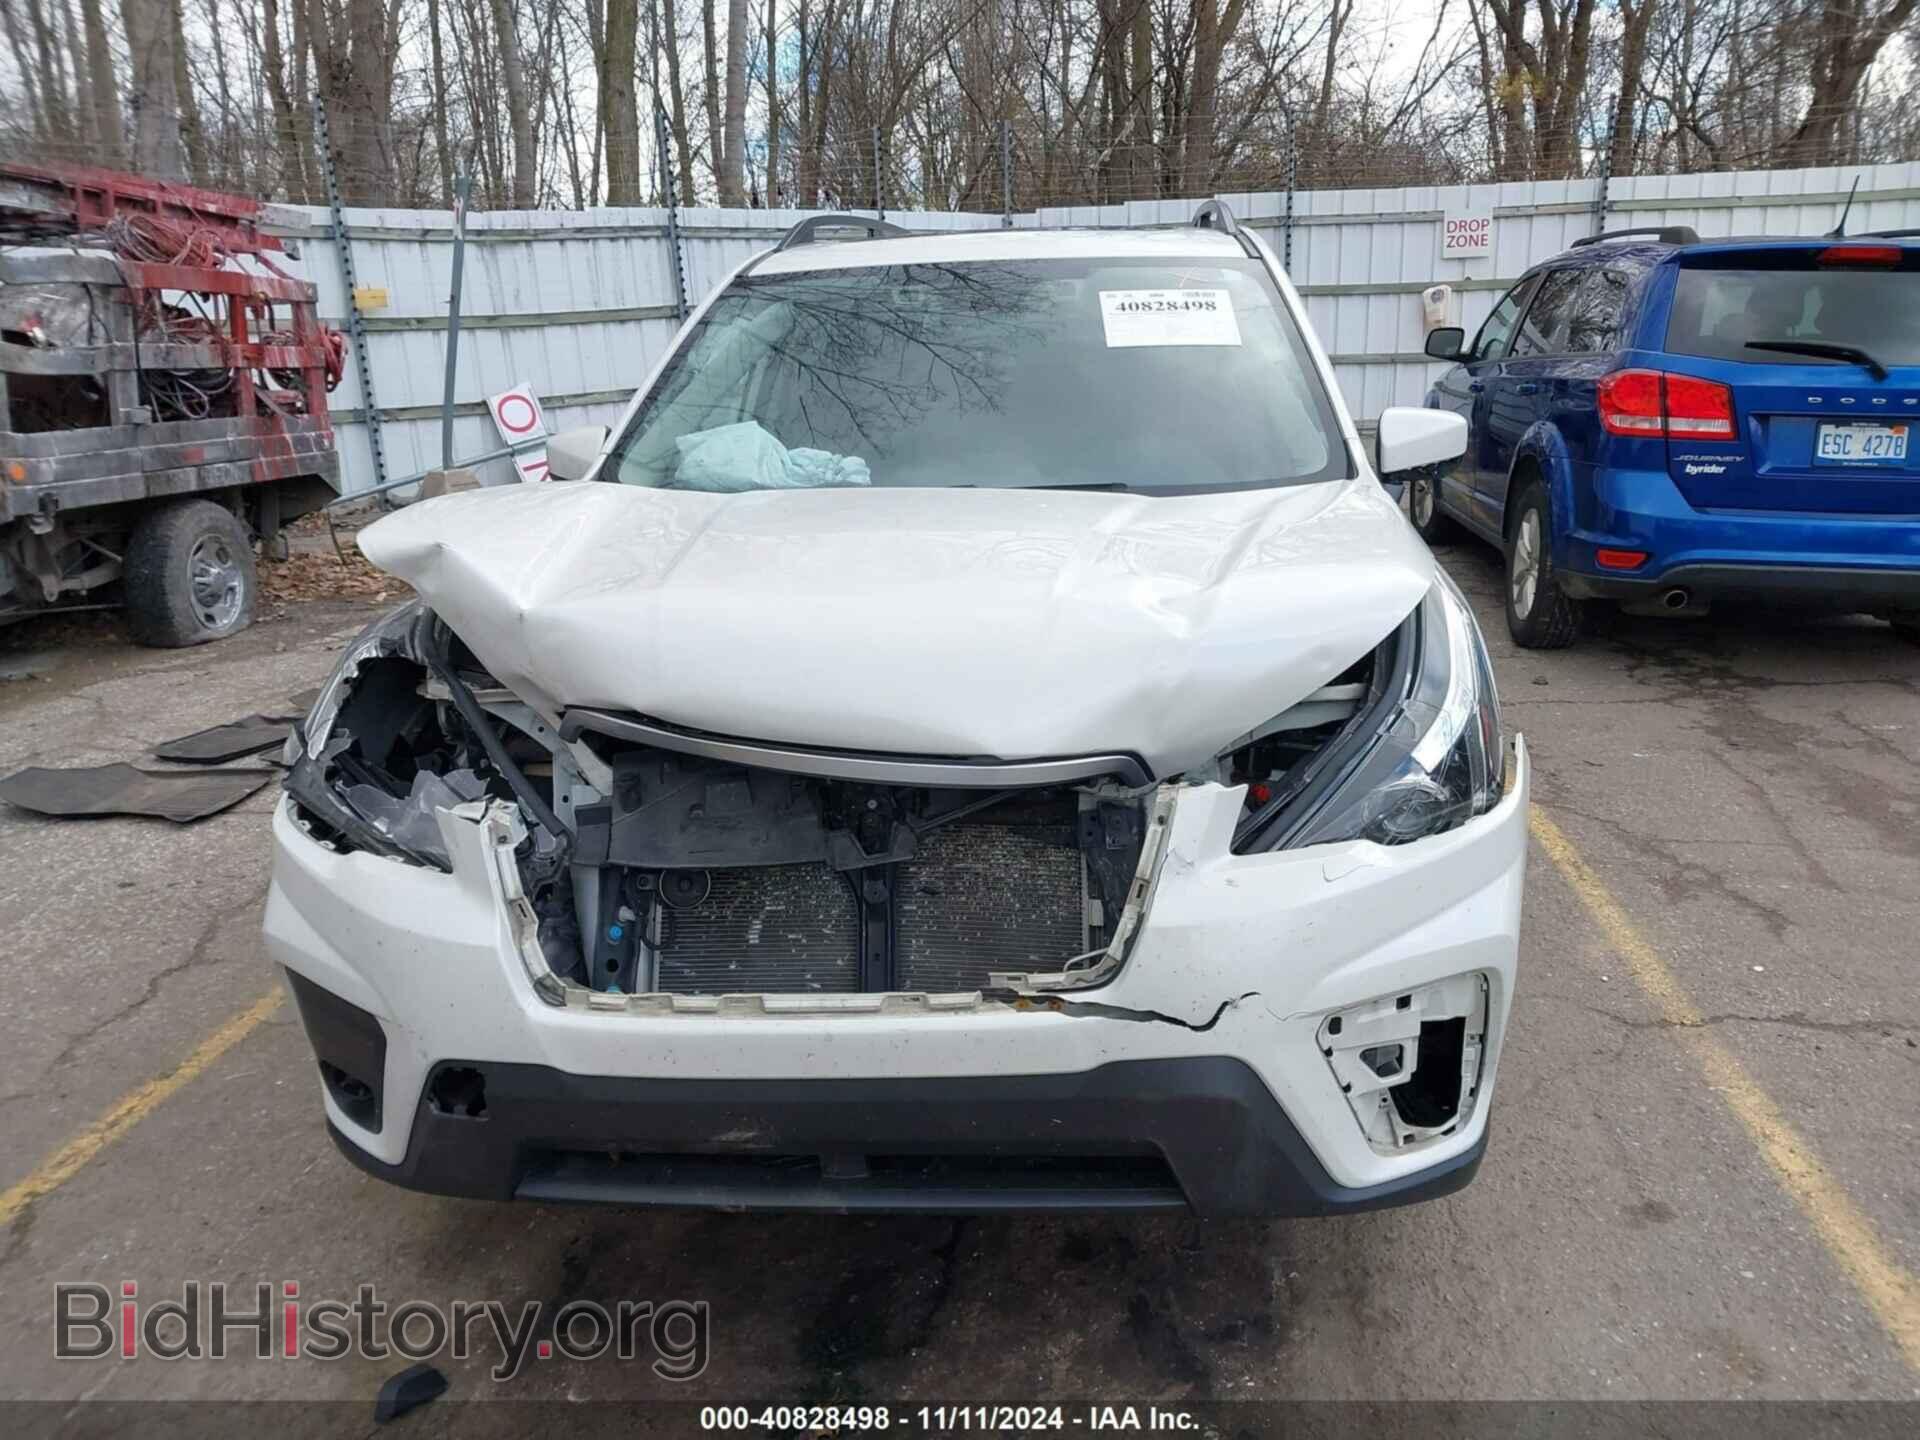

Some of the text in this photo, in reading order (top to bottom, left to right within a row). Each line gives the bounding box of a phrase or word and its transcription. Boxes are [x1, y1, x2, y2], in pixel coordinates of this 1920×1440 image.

[1446, 218, 1490, 233] DROP
[1446, 234, 1489, 248] ZONE
[1115, 300, 1217, 312] 40828498
[1822, 433, 1853, 455] ESC
[1684, 463, 1727, 475] byrider
